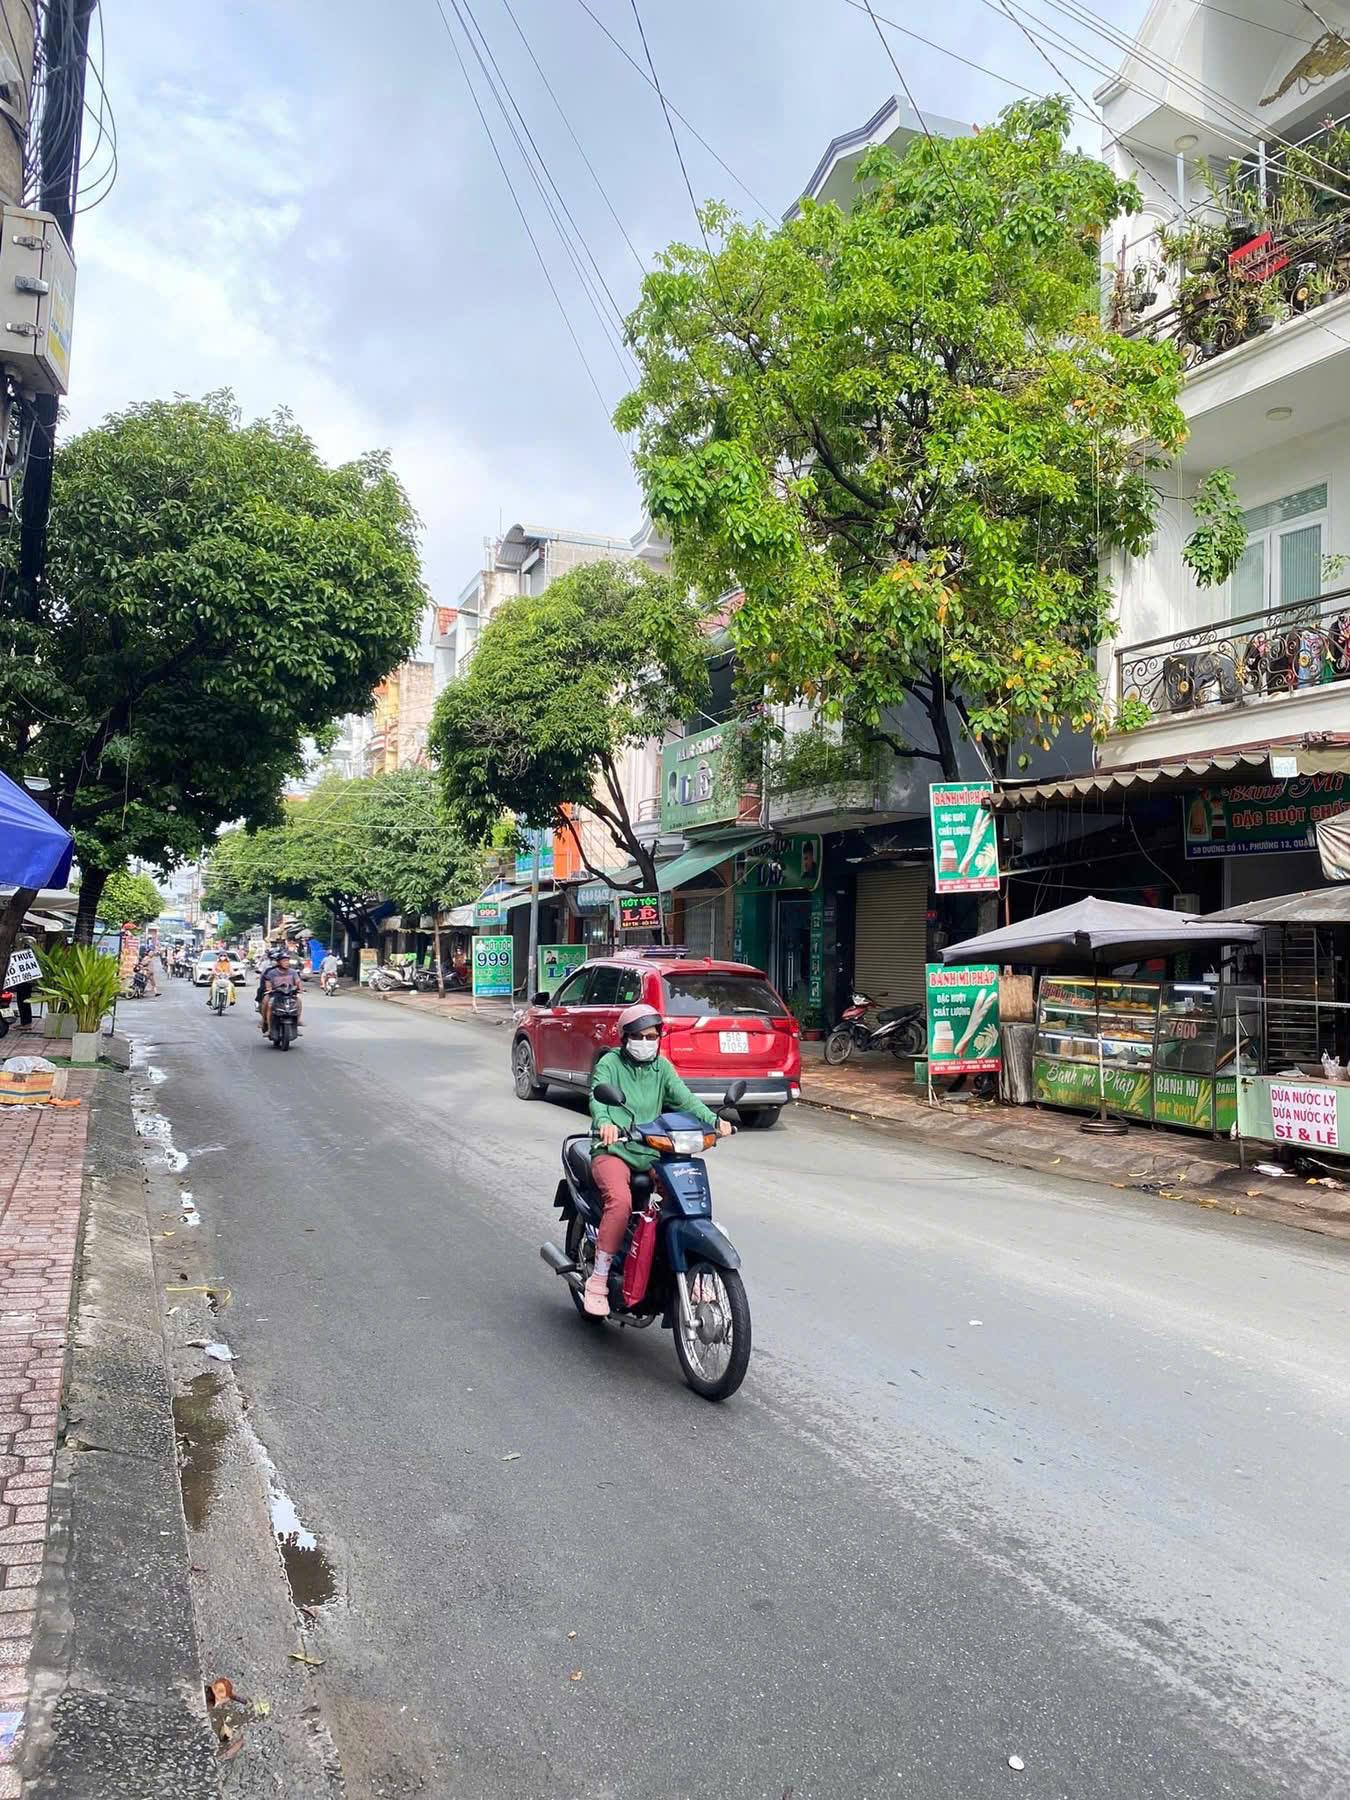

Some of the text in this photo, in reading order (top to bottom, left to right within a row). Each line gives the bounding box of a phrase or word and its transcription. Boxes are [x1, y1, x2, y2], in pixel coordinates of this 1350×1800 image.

[1231, 798, 1350, 829] ĐẶC RUỘT CHẤ
[623, 906, 657, 921] LÊ
[477, 952, 509, 967] 999
[930, 966, 996, 987] BÁNH MÌ PHÁP
[933, 1006, 971, 1018] CHẤT LƯỢNG
[1157, 1074, 1183, 1095] BÁNH
[1272, 1086, 1336, 1107] DỪA NƯỚC LY
[1273, 1104, 1336, 1125] DỪA NƯỚC KÝ
[1298, 1127, 1311, 1142] &
